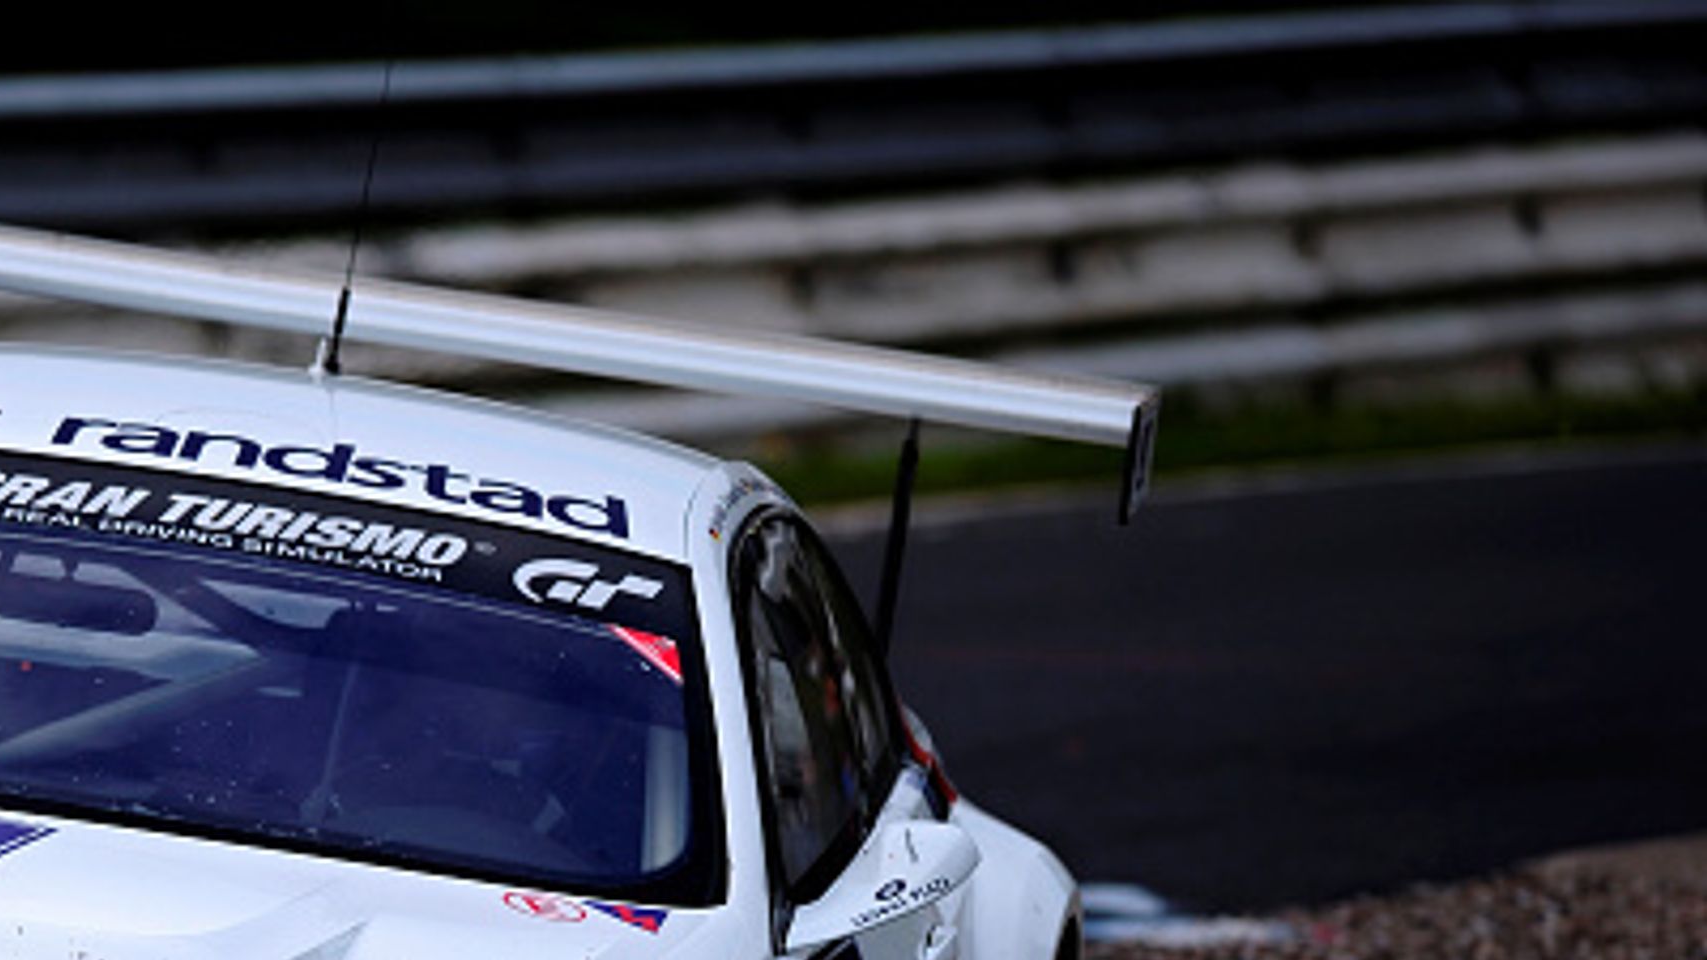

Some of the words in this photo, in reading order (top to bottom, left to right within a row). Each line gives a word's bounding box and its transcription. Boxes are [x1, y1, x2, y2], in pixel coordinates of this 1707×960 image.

[51, 417, 629, 539] randstad
[3, 508, 81, 528] REAL
[98, 519, 234, 549] DRIVING
[243, 538, 442, 582] SIMULATOR
[160, 493, 468, 567] TURISMO
